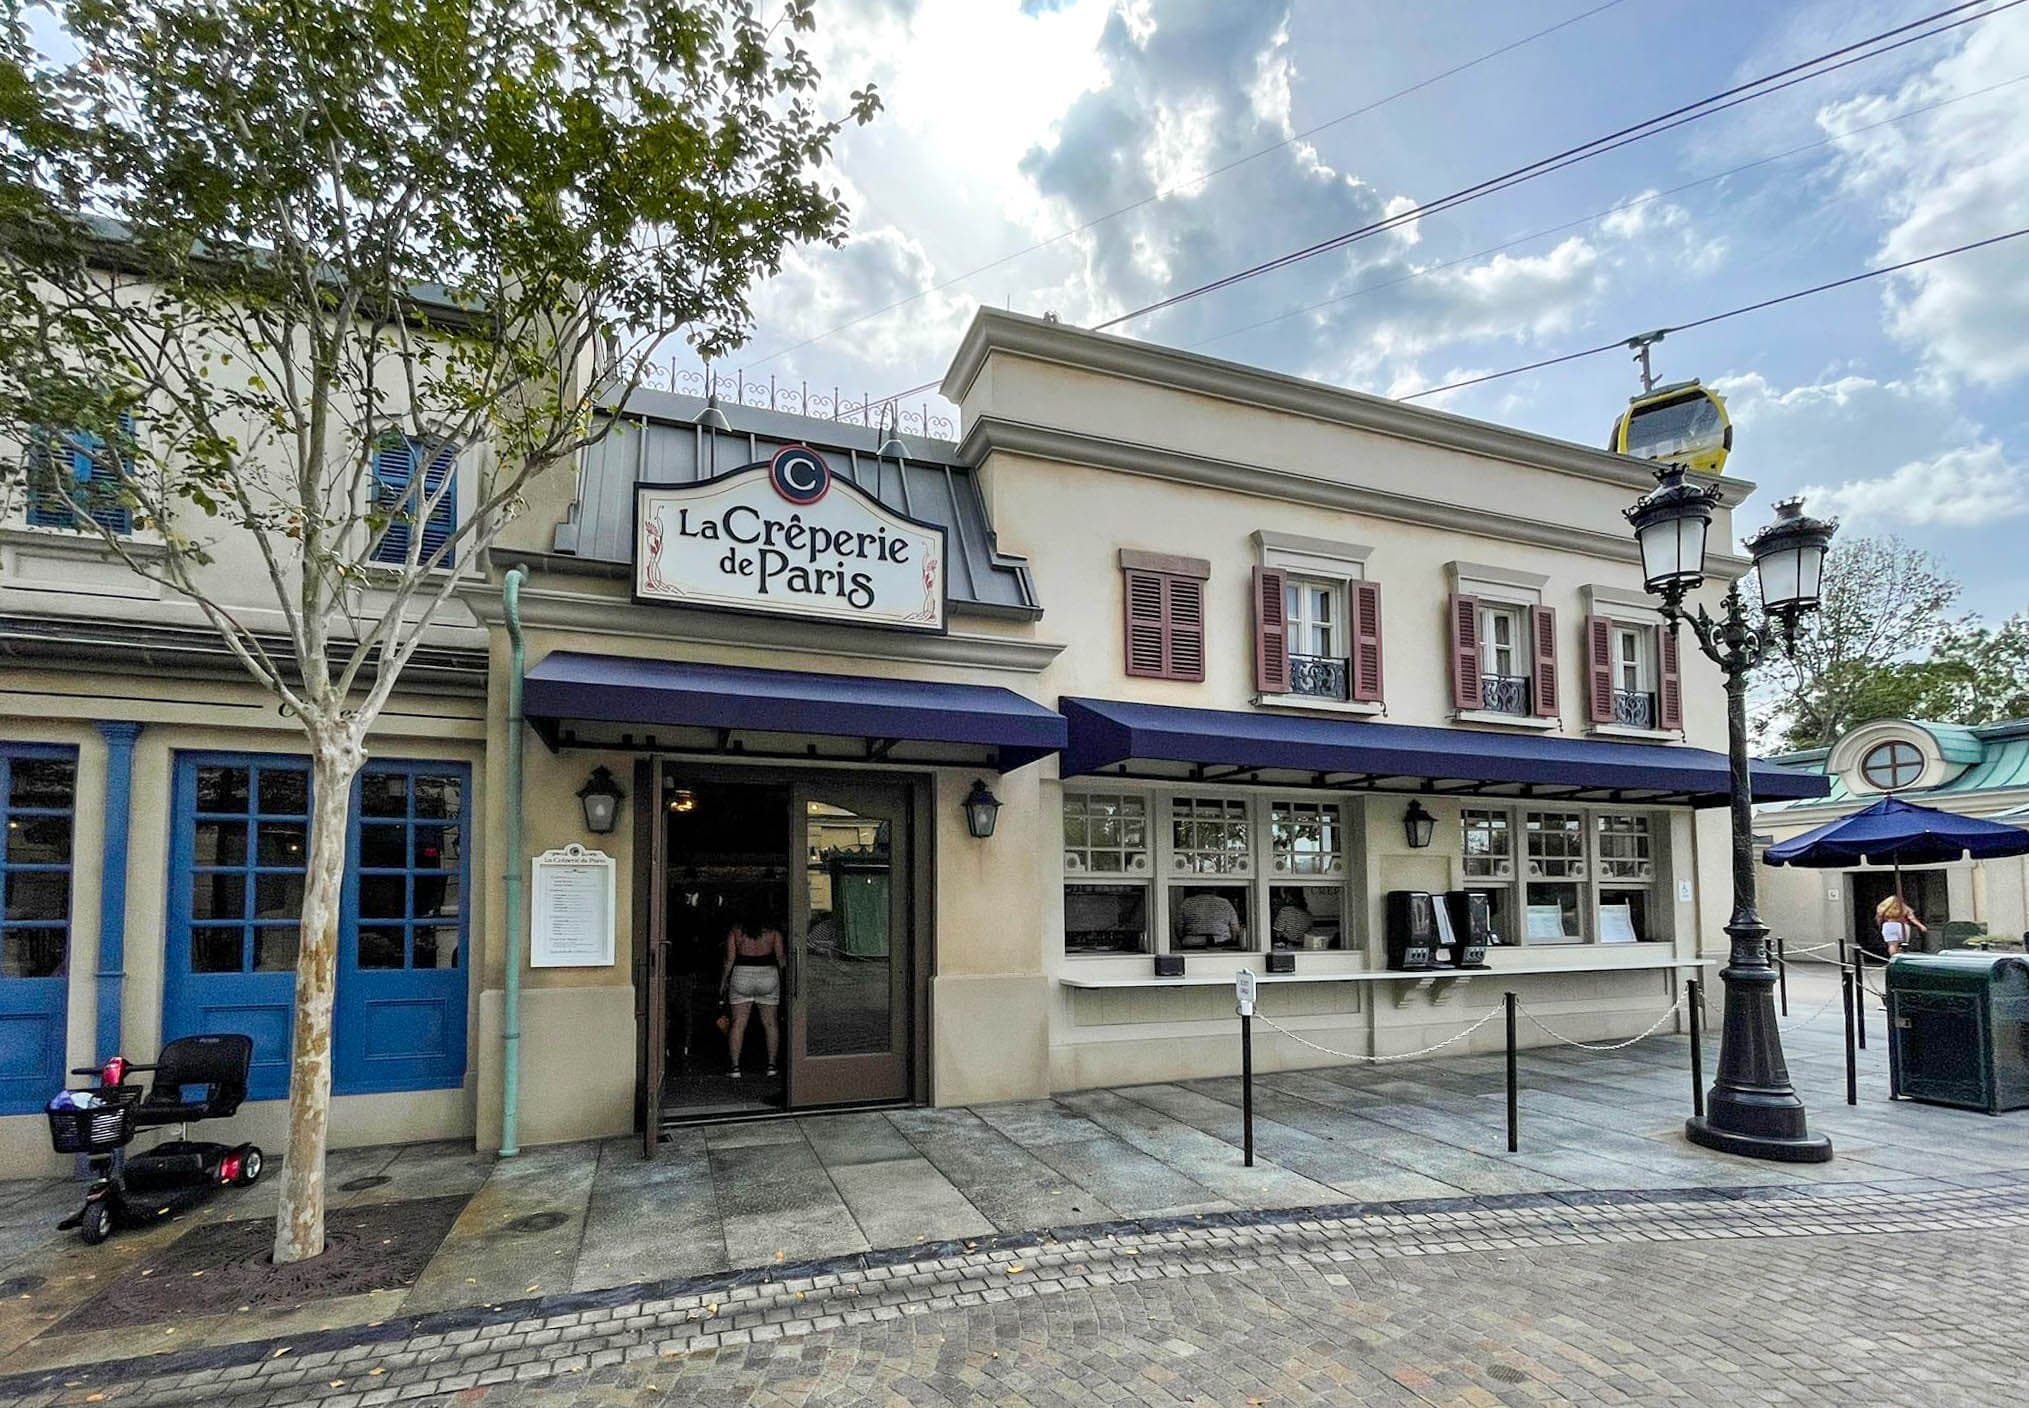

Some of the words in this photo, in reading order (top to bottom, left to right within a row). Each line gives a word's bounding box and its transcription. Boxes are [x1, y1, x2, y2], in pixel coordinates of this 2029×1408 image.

[784, 458, 816, 491] C
[680, 508, 720, 540] La
[722, 505, 910, 564] Crêperie
[719, 546, 754, 577] de
[757, 548, 876, 610] Paris
